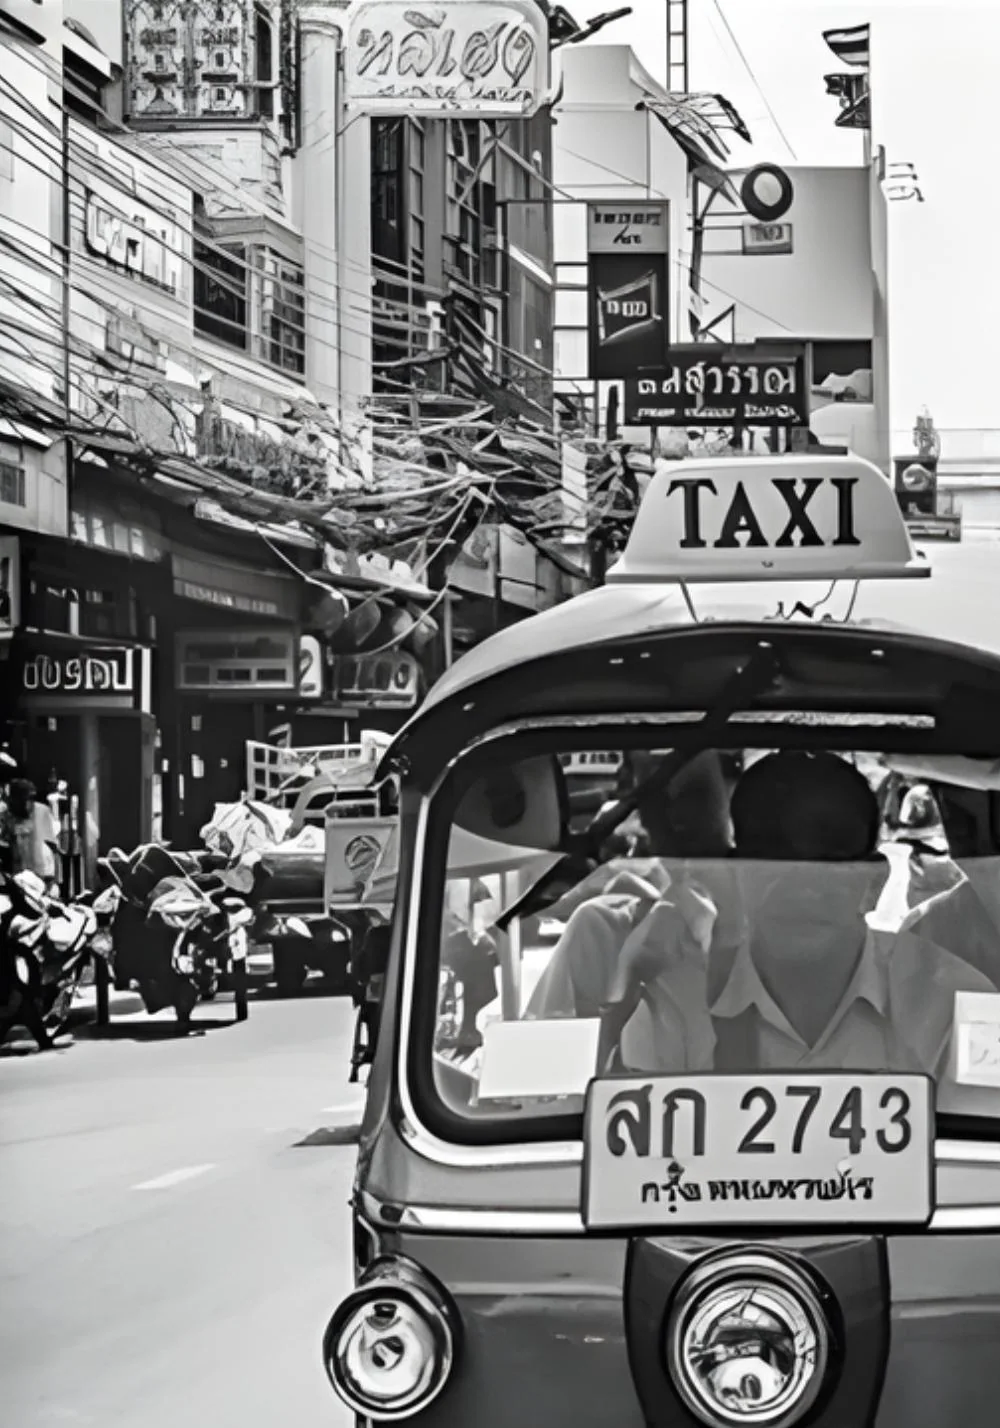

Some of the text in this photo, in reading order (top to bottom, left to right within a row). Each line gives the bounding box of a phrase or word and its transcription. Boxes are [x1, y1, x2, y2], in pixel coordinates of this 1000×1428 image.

[666, 477, 862, 549] TAXI
[605, 1084, 912, 1158] สก 2743
